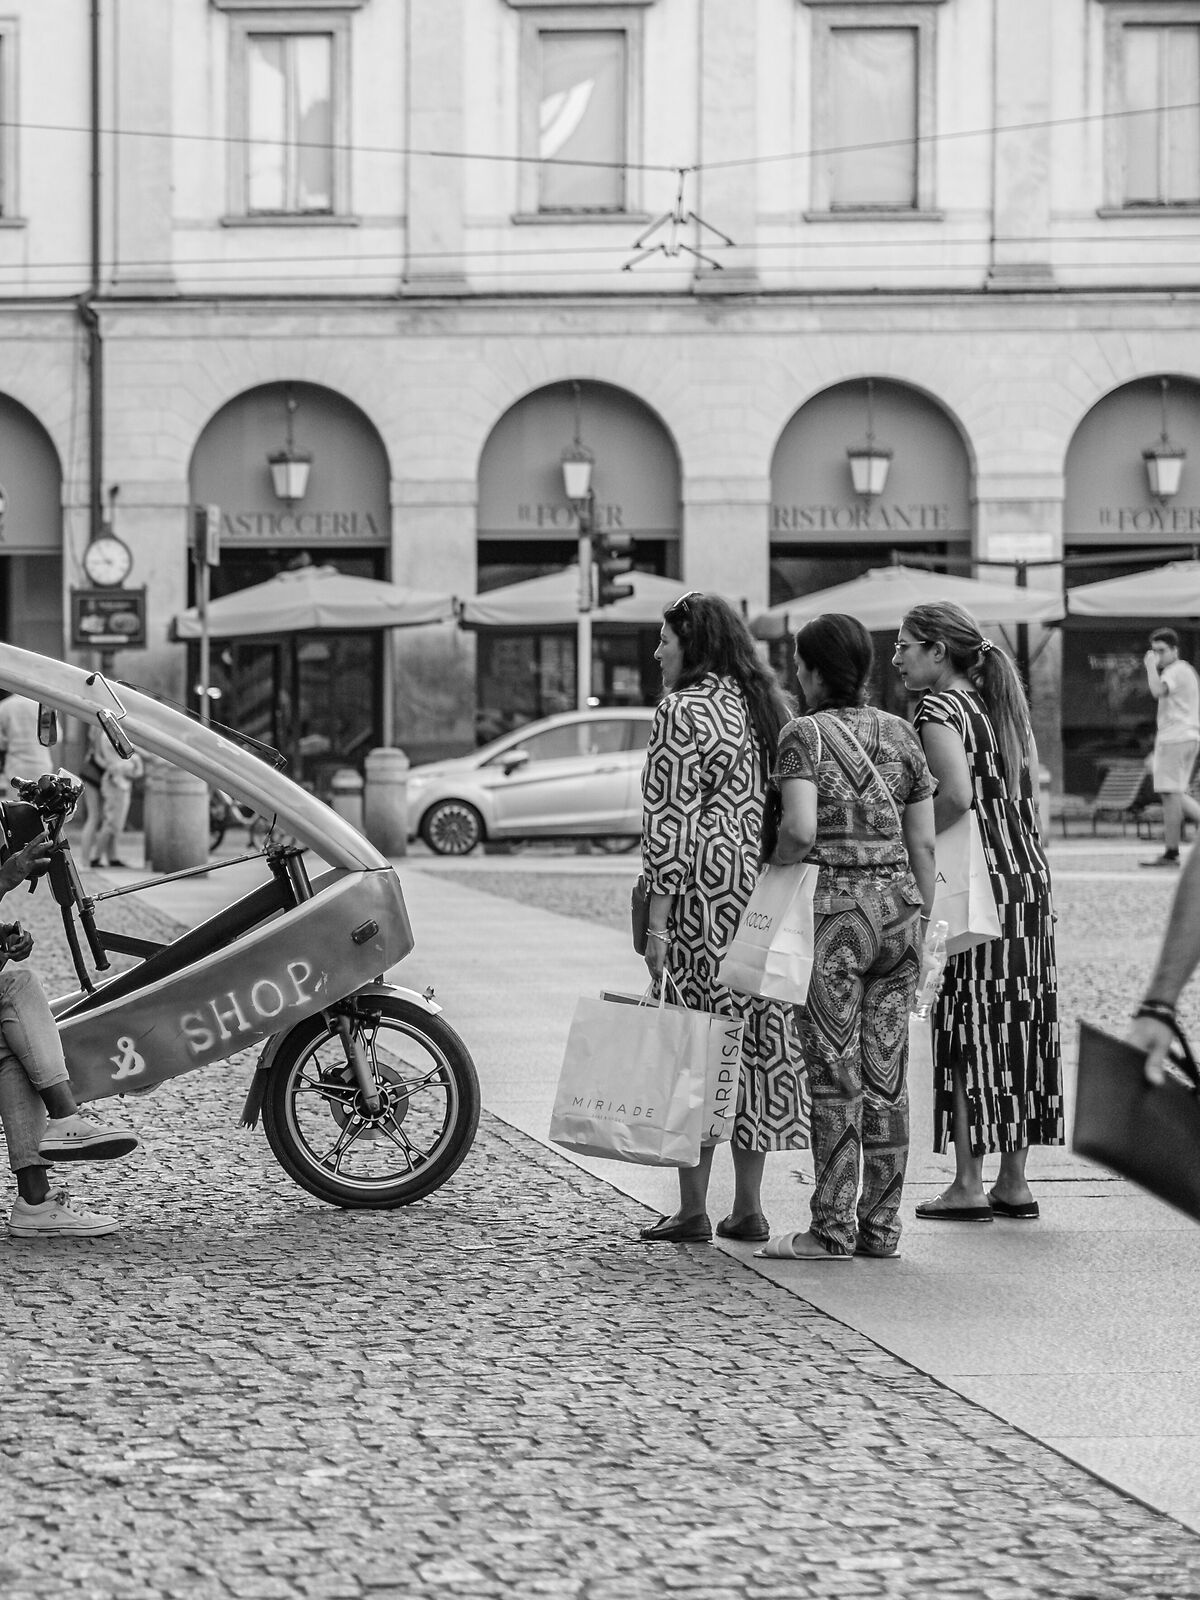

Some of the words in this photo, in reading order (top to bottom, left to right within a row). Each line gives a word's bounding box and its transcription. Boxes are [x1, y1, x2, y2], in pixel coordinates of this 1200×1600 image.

[218, 511, 379, 536] ASTICCERIA
[773, 505, 948, 529] RISTORANTE
[744, 912, 773, 932] KOCCA
[109, 1036, 146, 1081] &
[180, 961, 312, 1054] SHOP
[709, 1027, 742, 1138] CARPISA
[572, 1097, 655, 1118] MIRIADE
